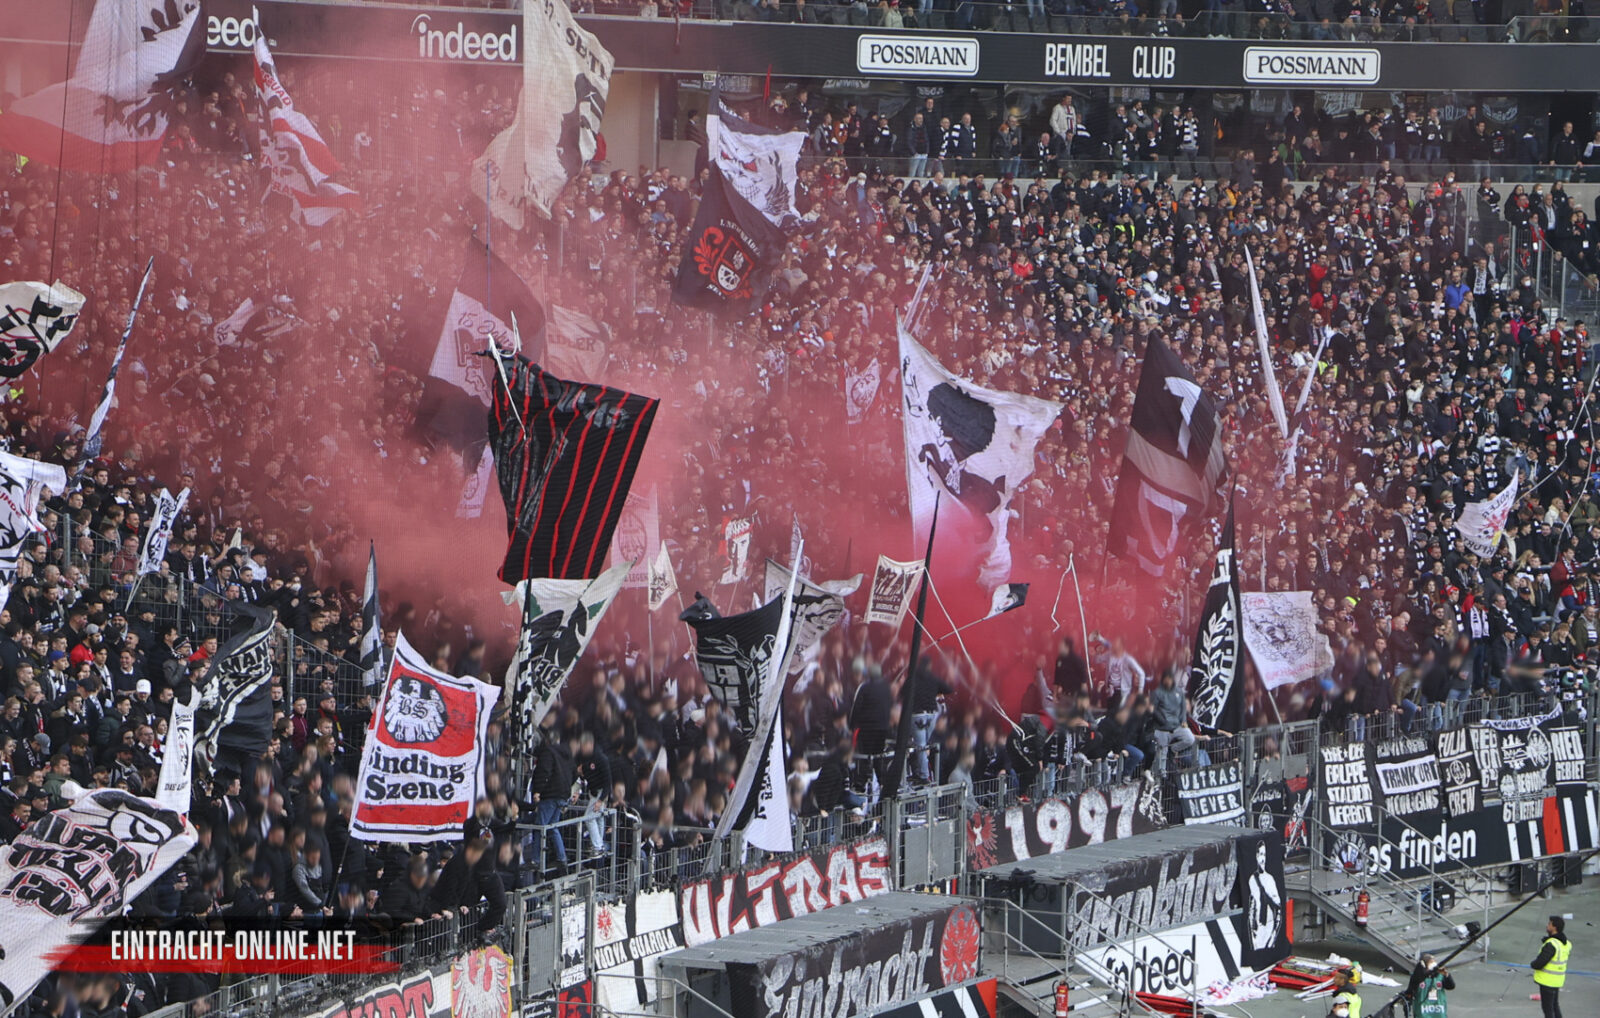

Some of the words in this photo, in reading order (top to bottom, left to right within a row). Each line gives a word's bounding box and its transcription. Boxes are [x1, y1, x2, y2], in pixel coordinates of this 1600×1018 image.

[411, 14, 517, 62] indeed
[869, 43, 968, 66] POSSMANN
[1044, 43, 1111, 77] BEMBEL
[1132, 45, 1176, 79] CLUB
[1257, 55, 1367, 75] POSSMANN
[1550, 730, 1585, 762] RIED
[1180, 766, 1237, 791] ULTRAS
[1325, 760, 1368, 785] GRUPPE
[1382, 760, 1439, 790] FRANKURT
[1555, 760, 1586, 782] GEBIET
[365, 774, 456, 801] Szene
[1188, 793, 1240, 817] NEVER
[1328, 804, 1373, 826] VERBOT
[1448, 787, 1476, 818] CREW
[1004, 781, 1142, 861] 1997
[1399, 819, 1477, 870] finden
[683, 837, 893, 948] ULTRAS
[1099, 934, 1197, 994] indeed
[1420, 1004, 1445, 1015] HOST
